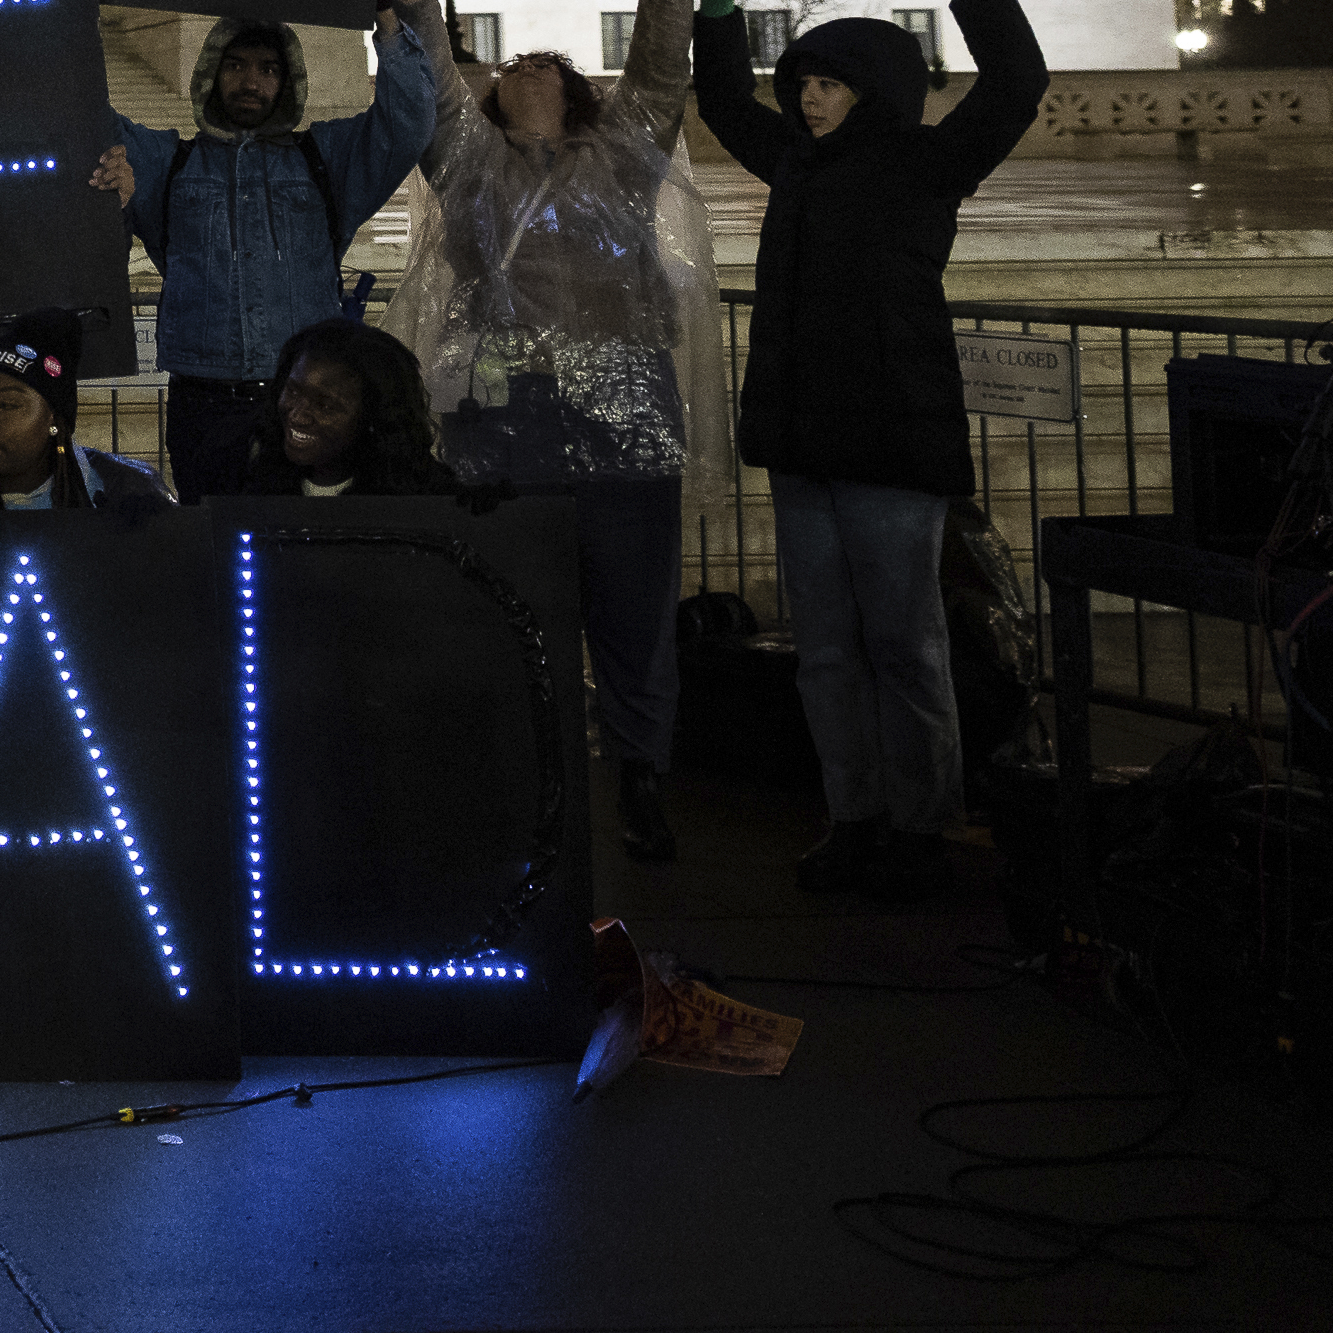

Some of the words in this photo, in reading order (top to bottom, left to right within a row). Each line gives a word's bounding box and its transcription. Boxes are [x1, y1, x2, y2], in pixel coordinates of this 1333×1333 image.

[959, 344, 991, 364] REA
[996, 348, 1059, 370] CLOSED
[680, 986, 779, 1030] AMILIES
